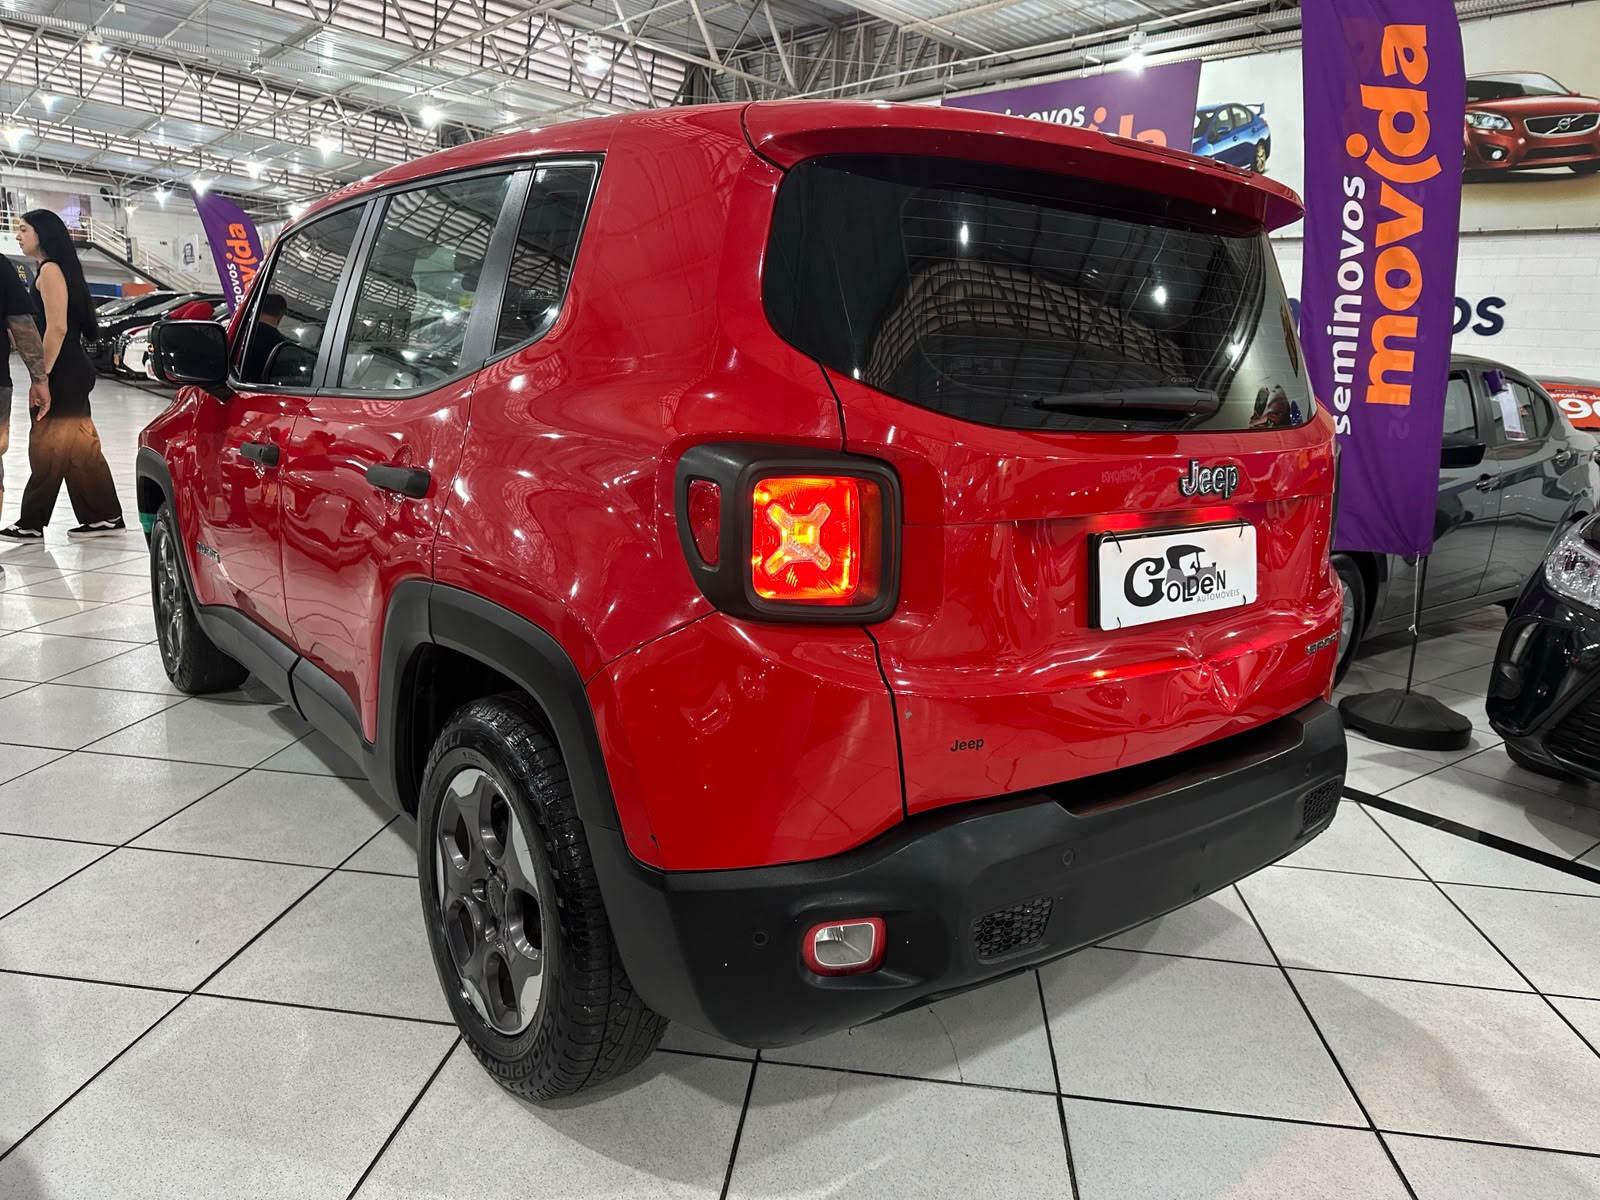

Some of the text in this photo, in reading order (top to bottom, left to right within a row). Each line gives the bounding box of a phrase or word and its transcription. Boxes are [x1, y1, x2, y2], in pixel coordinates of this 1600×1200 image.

[1327, 176, 1366, 435] seminovos
[1179, 459, 1239, 499] Jeep
[950, 738, 985, 752] Jeep
